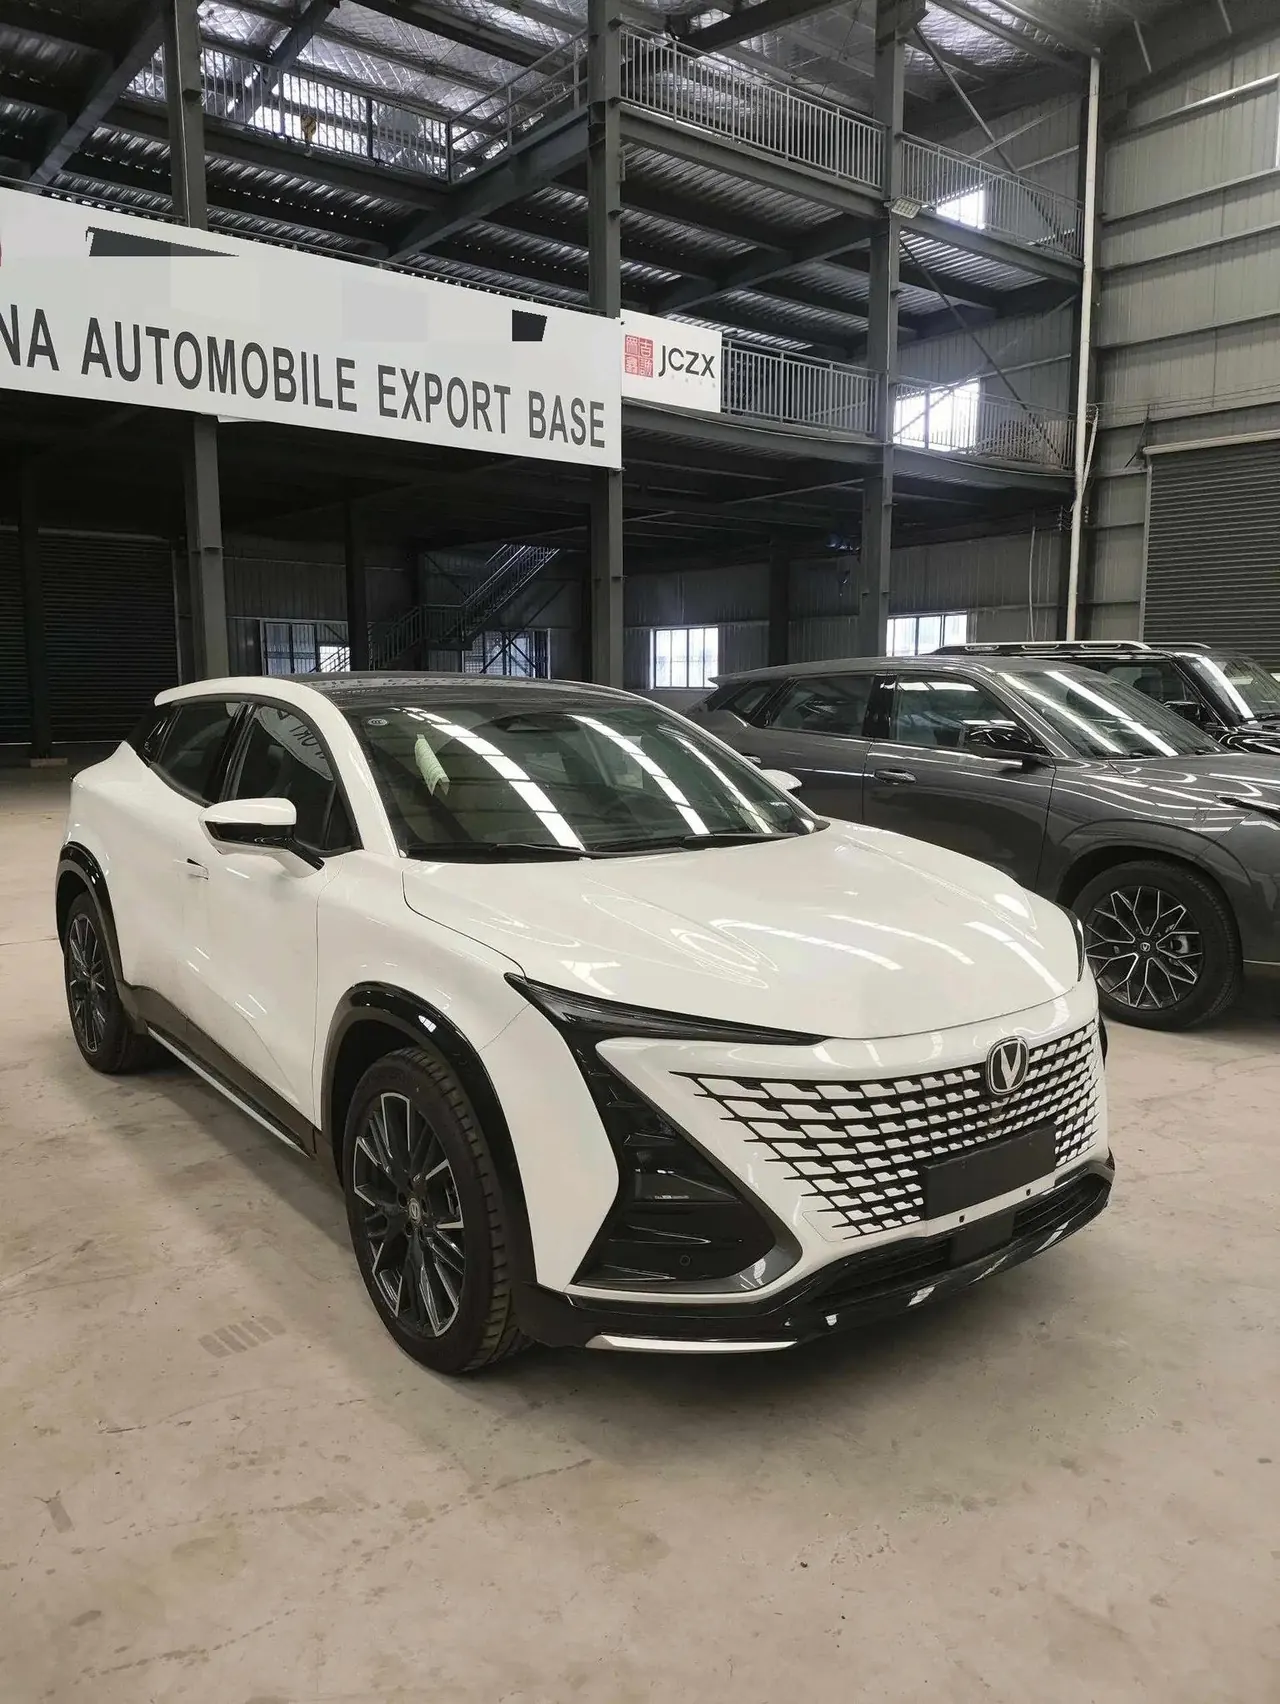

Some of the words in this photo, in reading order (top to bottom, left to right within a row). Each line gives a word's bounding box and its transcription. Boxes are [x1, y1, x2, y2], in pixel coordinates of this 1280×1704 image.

[81, 317, 358, 413] AUTOMOBILE
[378, 365, 511, 435] EXPORT
[529, 391, 605, 449] BASE
[658, 345, 715, 379] JCZX
